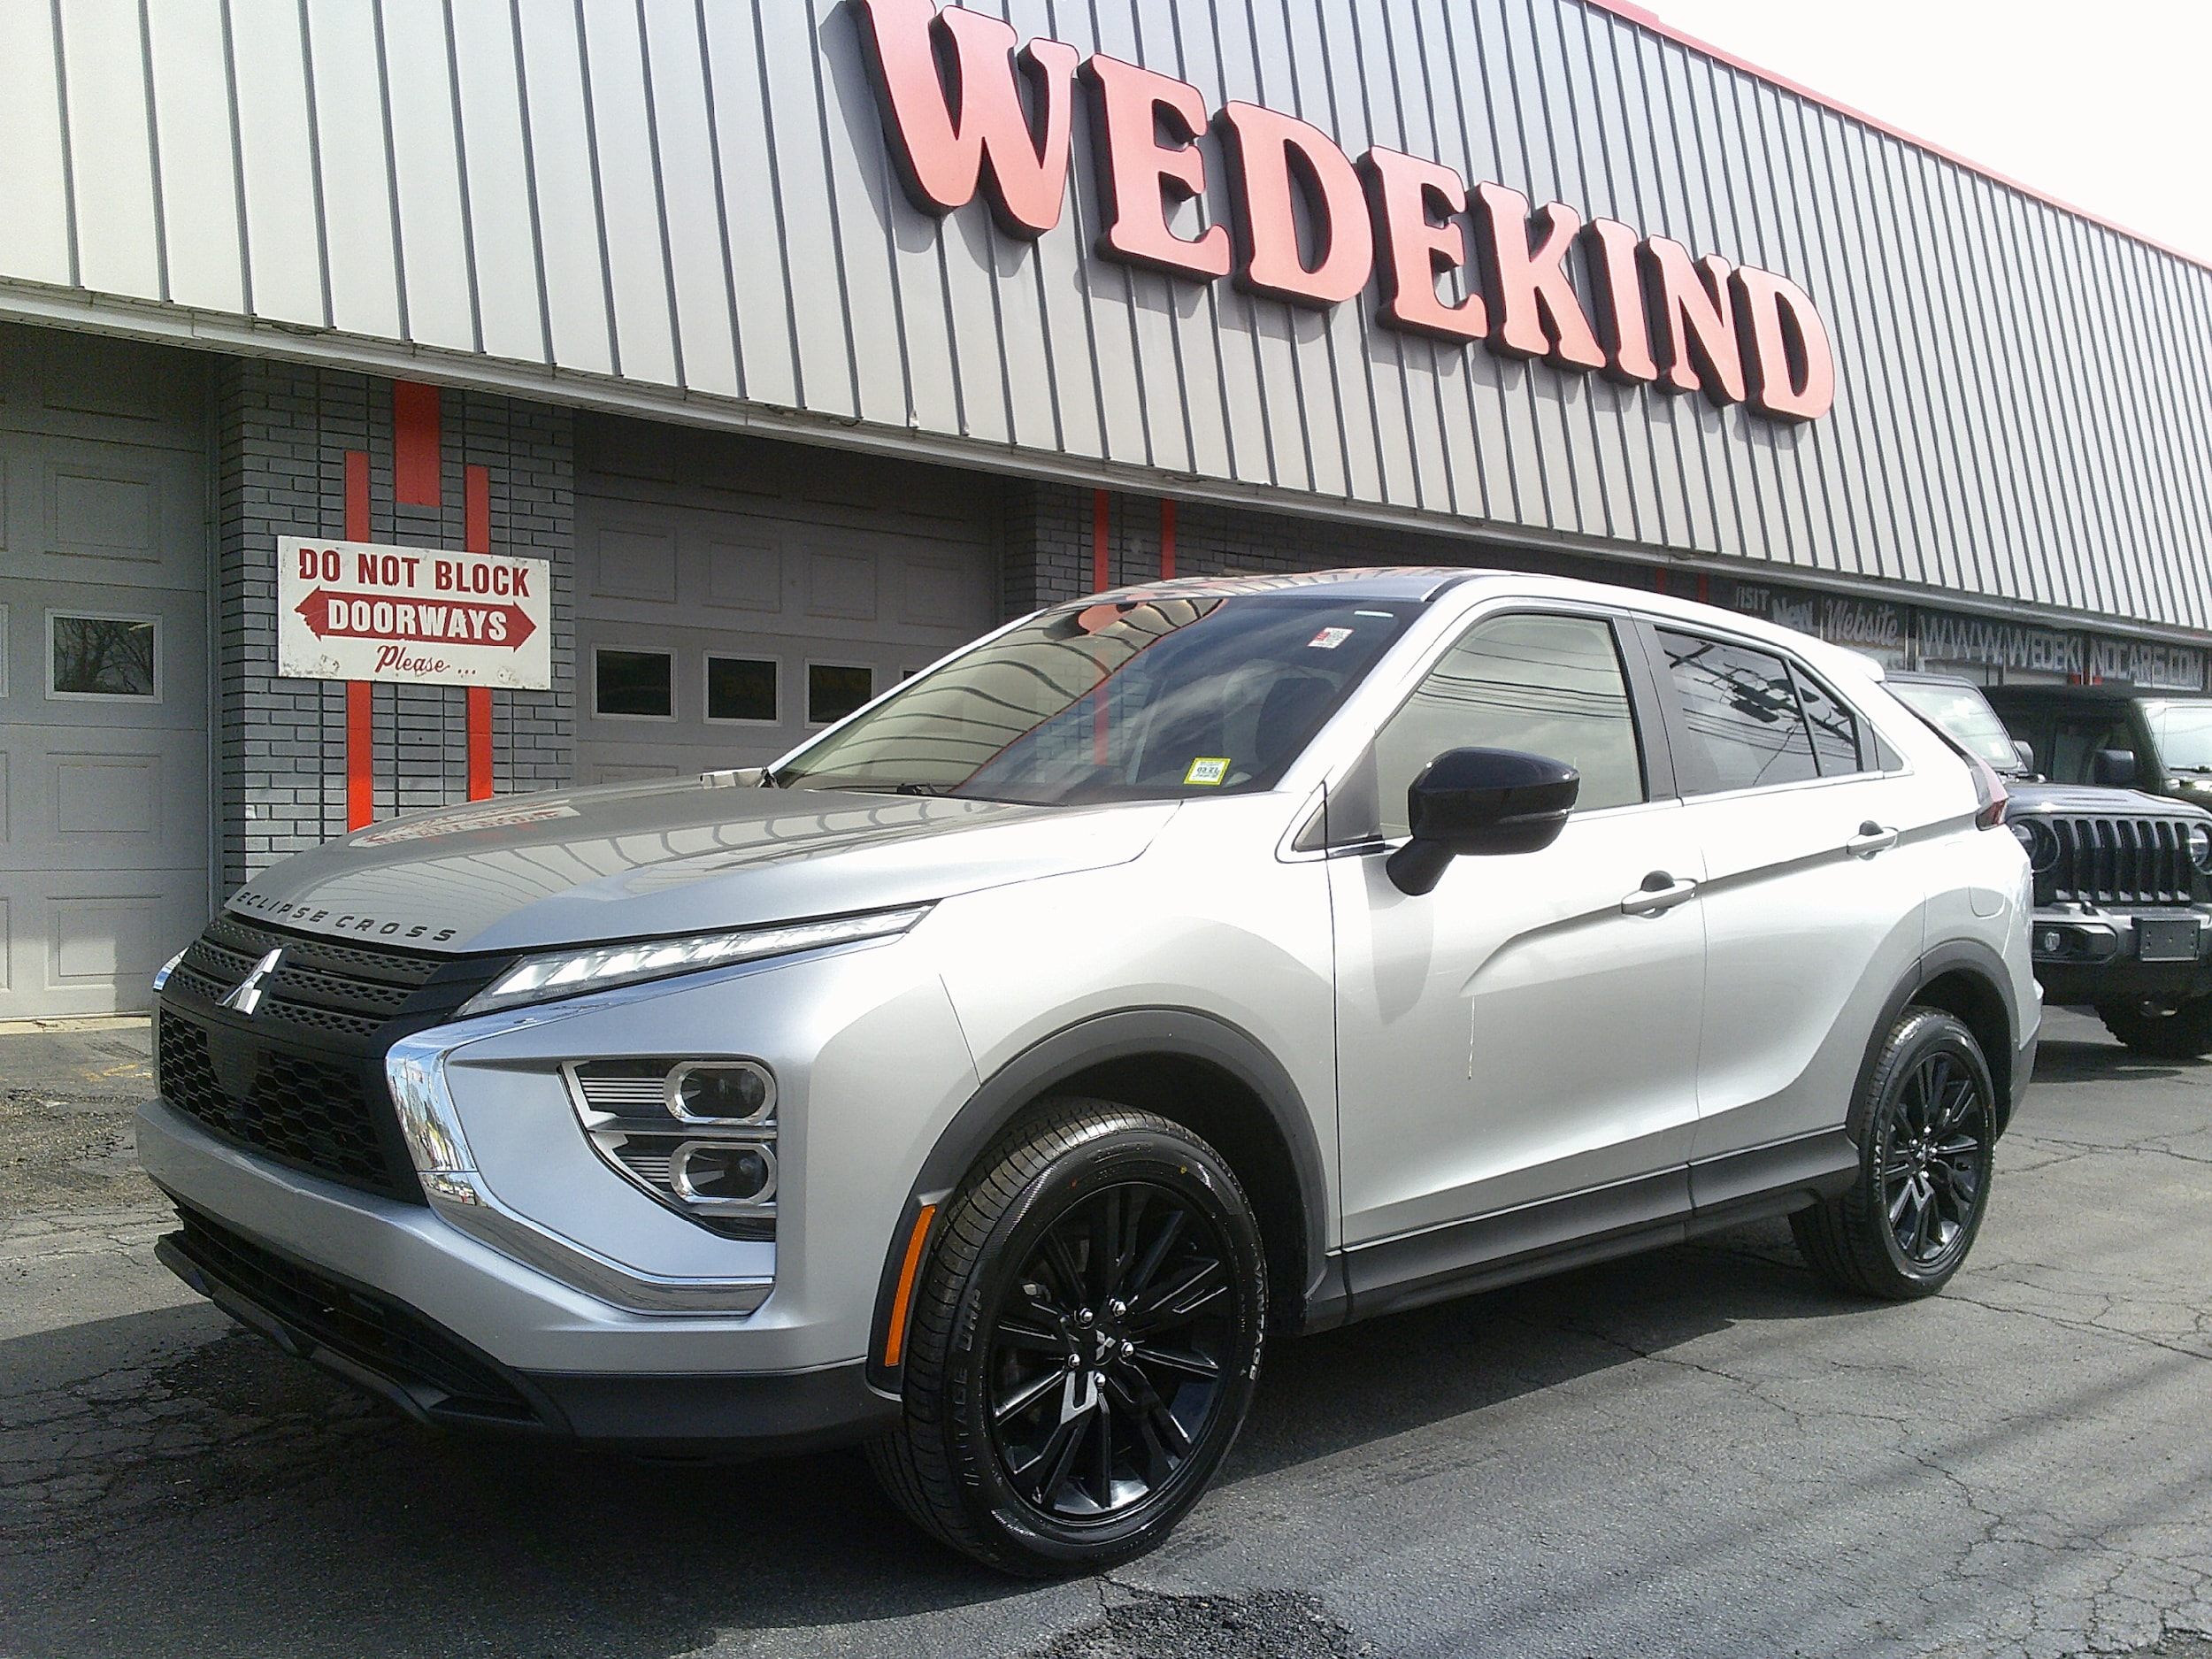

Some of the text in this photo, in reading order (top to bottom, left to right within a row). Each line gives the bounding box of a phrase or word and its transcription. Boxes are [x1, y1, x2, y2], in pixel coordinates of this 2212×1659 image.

[861, 0, 1836, 424] WEDEKIND
[299, 548, 531, 598] DO NOT BLOCK
[326, 598, 508, 641] DOORWAYS
[374, 644, 451, 674] Please
[236, 891, 457, 942] ECLIPSE CROSS
